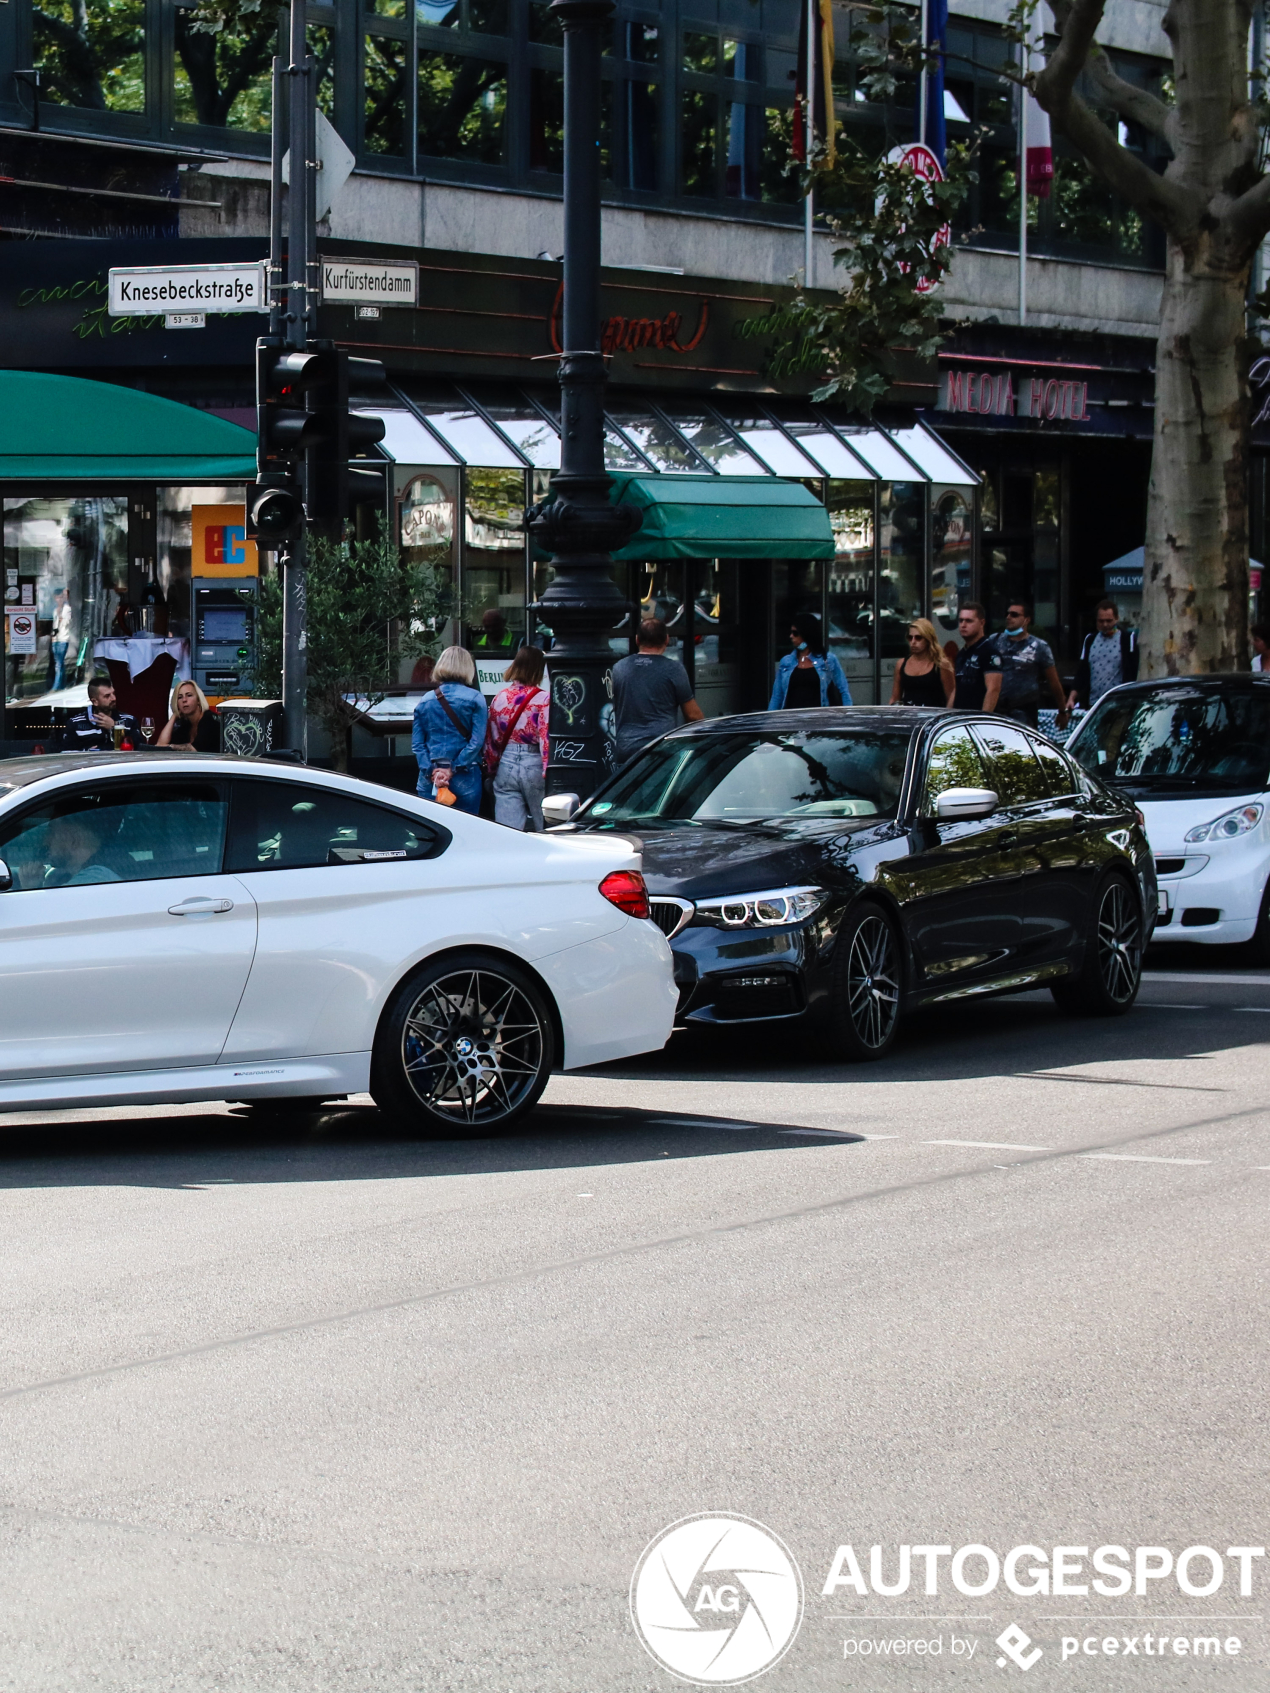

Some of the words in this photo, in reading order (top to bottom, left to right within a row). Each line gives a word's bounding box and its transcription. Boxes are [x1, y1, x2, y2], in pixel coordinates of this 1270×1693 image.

[121, 278, 254, 304] Knesebeckstraße
[324, 268, 412, 294] Kurfürstendamm
[948, 371, 1014, 417] MEDIA
[1031, 378, 1090, 421] HOTEL
[1109, 576, 1144, 586] HOLLYW
